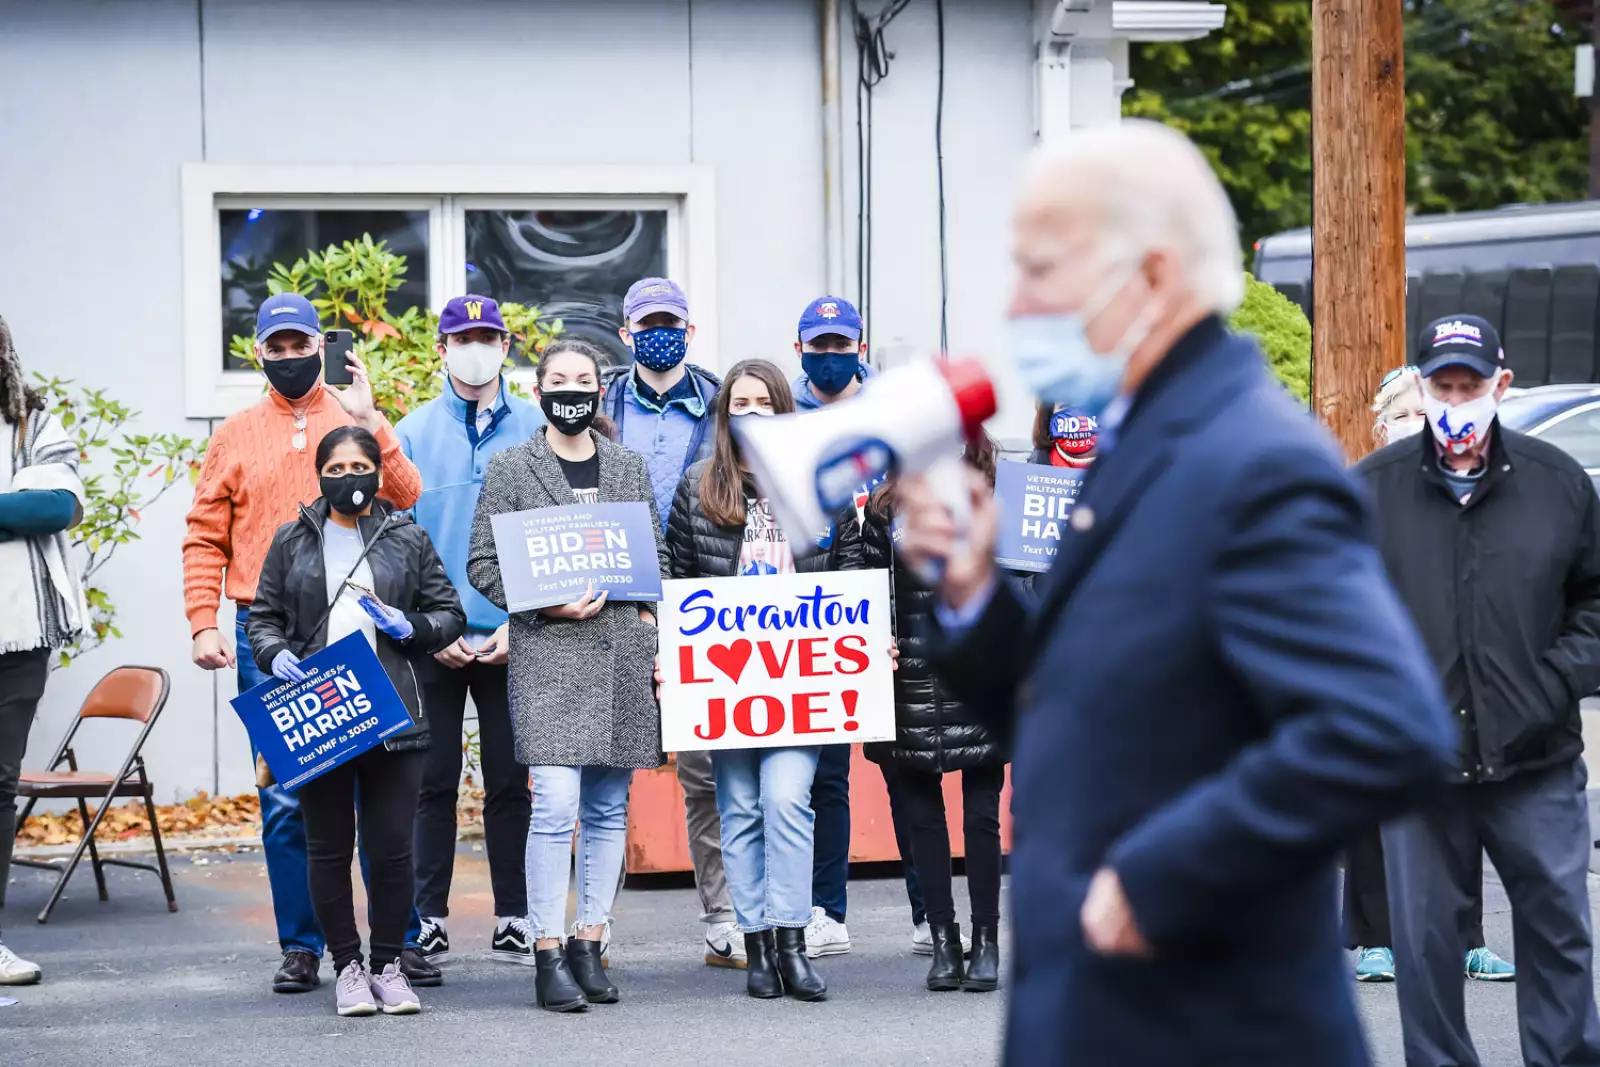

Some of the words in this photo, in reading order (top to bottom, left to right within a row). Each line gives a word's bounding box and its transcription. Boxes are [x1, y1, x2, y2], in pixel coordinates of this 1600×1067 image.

[464, 301, 483, 320] W
[552, 400, 593, 419] BIDEN
[1056, 416, 1097, 433] BIDEN
[1025, 485, 1069, 496] MILITARY
[1026, 475, 1076, 487] VETERANS
[1023, 494, 1076, 520] BID
[523, 515, 572, 528] VETERANS
[573, 513, 593, 521] AND
[524, 524, 567, 536] MILITARY
[568, 521, 609, 529] FAMILIES
[526, 529, 628, 558] BIDEN
[1022, 544, 1043, 555] Text
[530, 552, 633, 578] HARRIS
[536, 582, 558, 592] Text
[559, 576, 585, 588] VMF
[588, 577, 598, 586] to
[599, 575, 633, 584] 30330
[679, 585, 870, 636] Scranton
[260, 680, 297, 702] VETERAN
[265, 687, 301, 711] MILITARY
[301, 668, 337, 692] FAMILIES
[336, 664, 346, 675] for
[270, 669, 362, 733] BIDEN
[283, 693, 372, 752] HARRIS
[694, 690, 859, 741] JOE!
[297, 752, 317, 766] Text
[314, 737, 338, 756] VMF
[338, 733, 348, 743] to
[347, 716, 379, 737] 30330
